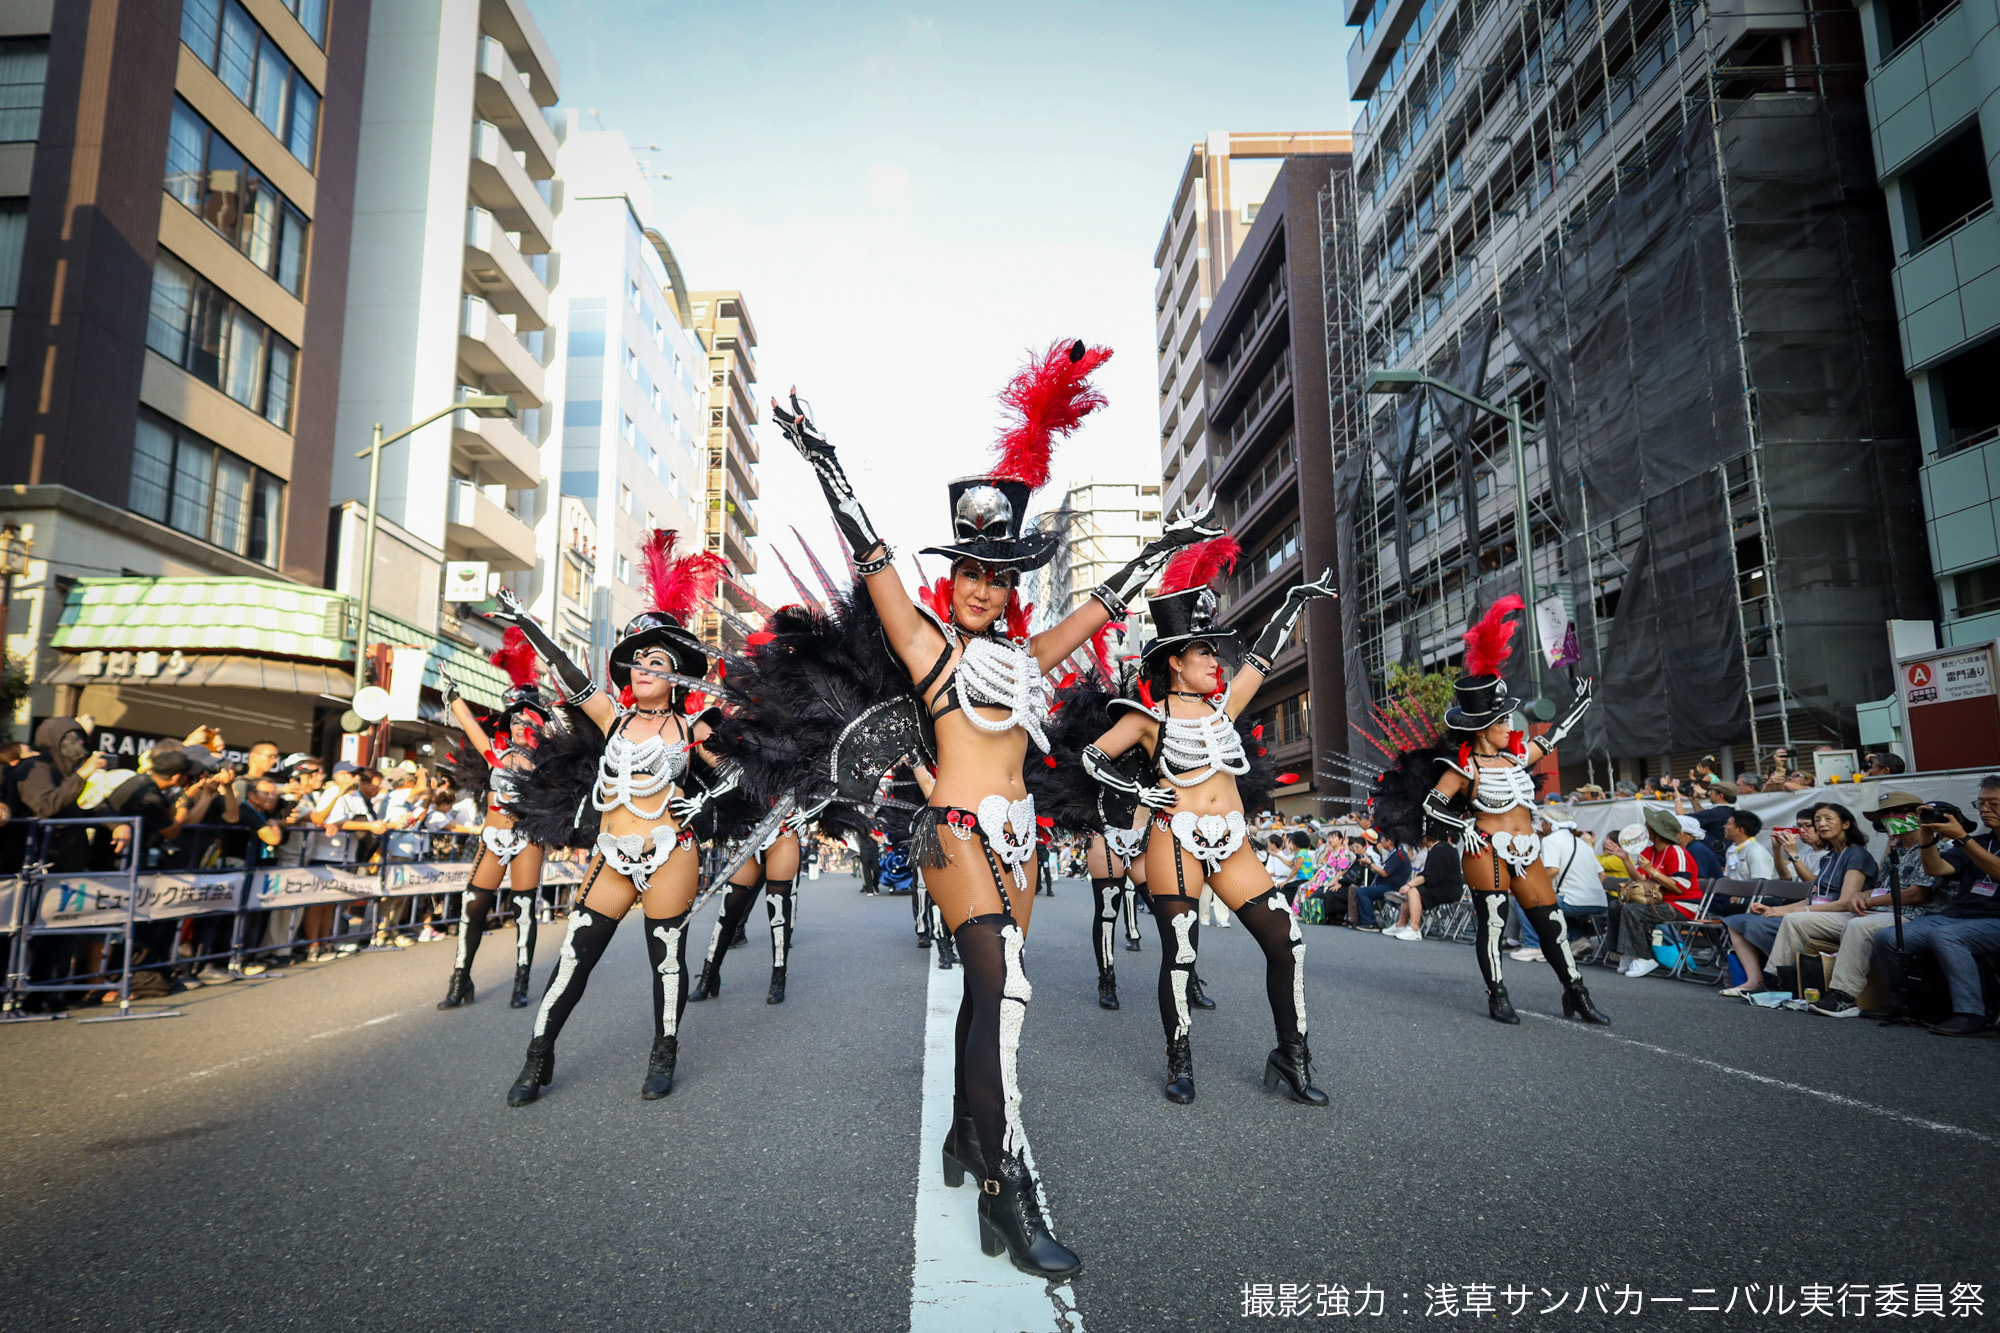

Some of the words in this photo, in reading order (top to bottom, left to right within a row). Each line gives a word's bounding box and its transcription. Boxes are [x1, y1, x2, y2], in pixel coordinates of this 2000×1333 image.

[1913, 667, 1928, 684] A
[1946, 666, 1985, 682] 雷門通り
[100, 733, 156, 758] RAM
